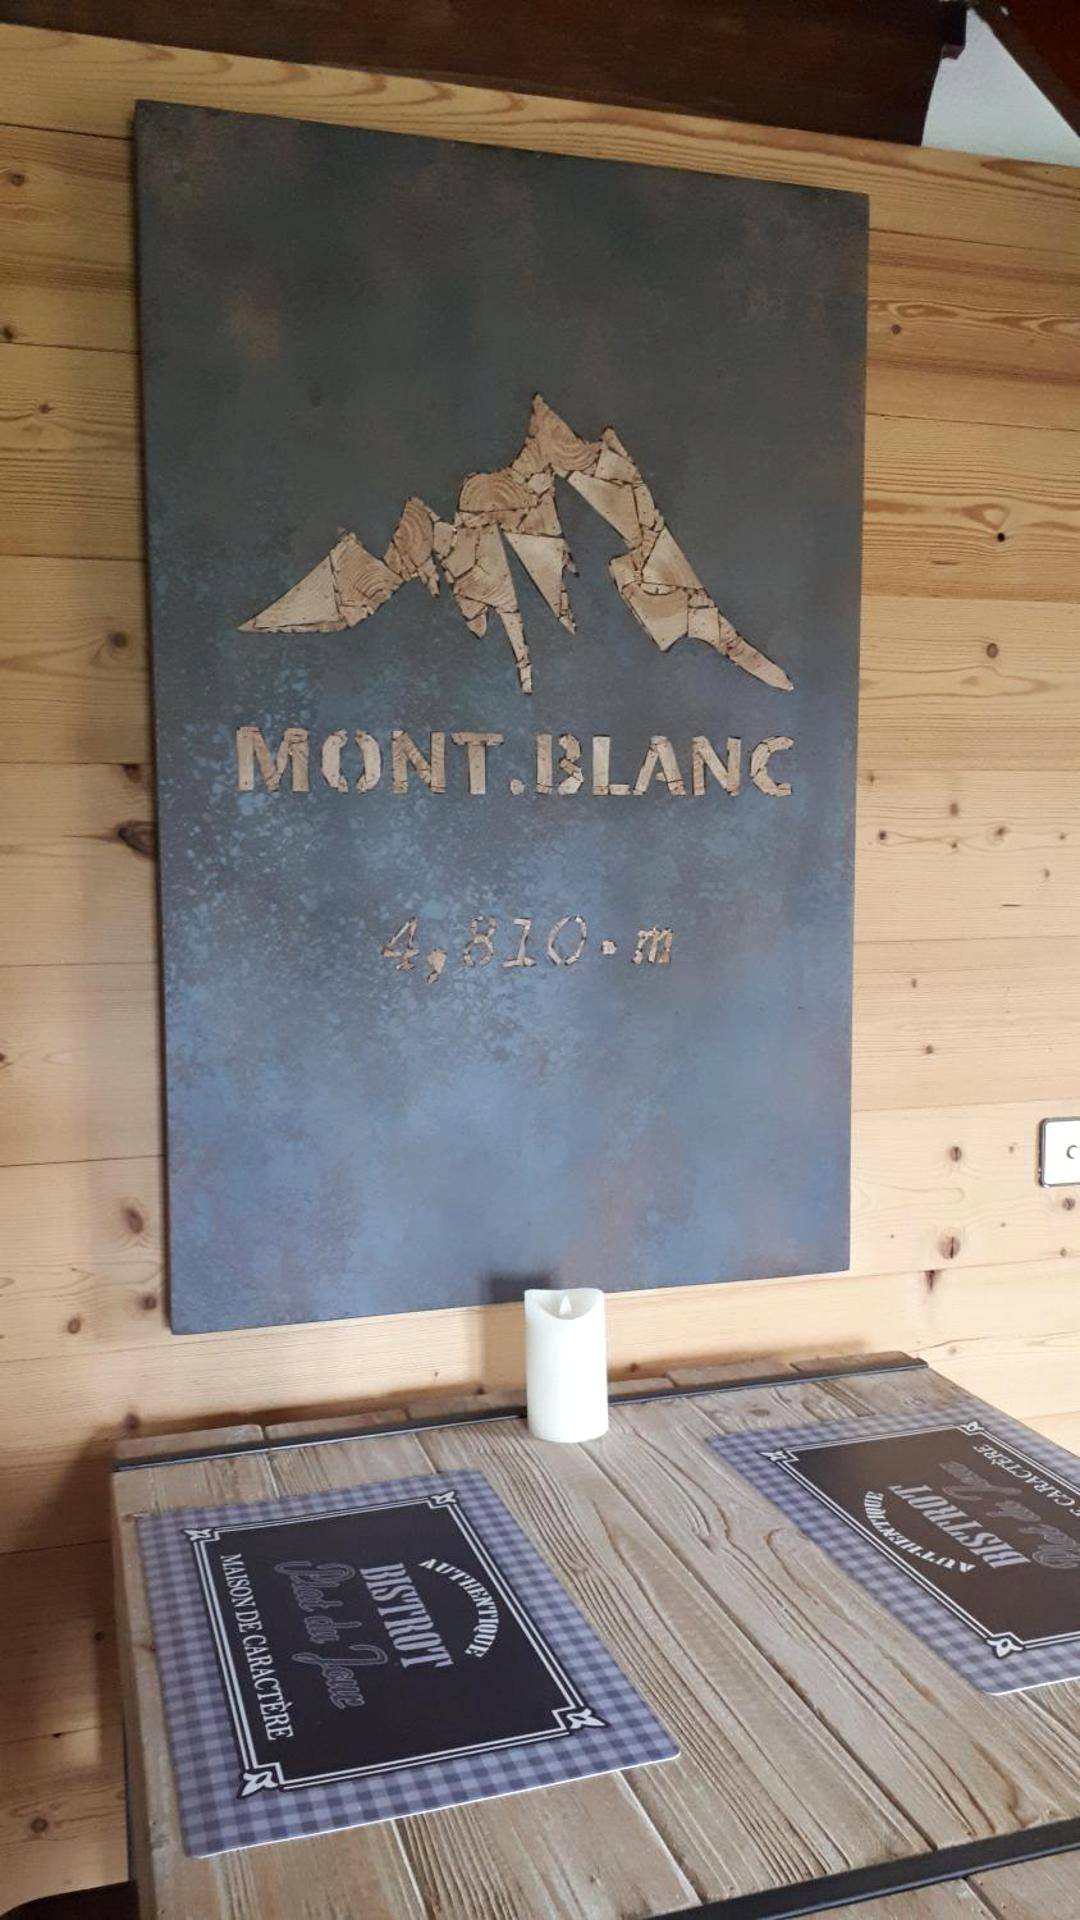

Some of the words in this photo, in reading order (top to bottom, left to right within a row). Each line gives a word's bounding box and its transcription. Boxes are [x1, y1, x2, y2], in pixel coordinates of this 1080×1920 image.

[863, 1490, 977, 1574] AUTHENTIQUE
[887, 1484, 1032, 1569] BISTROT
[219, 1553, 257, 1607] MAISON
[273, 1560, 356, 1613] Plat
[359, 1562, 455, 1670] BISTROT
[418, 1557, 500, 1659] AUTHENTIQUE
[235, 1609, 263, 1633] DE
[303, 1615, 363, 1645] du
[242, 1634, 295, 1741] CARACTÈRE
[291, 1644, 389, 1710] Jour
